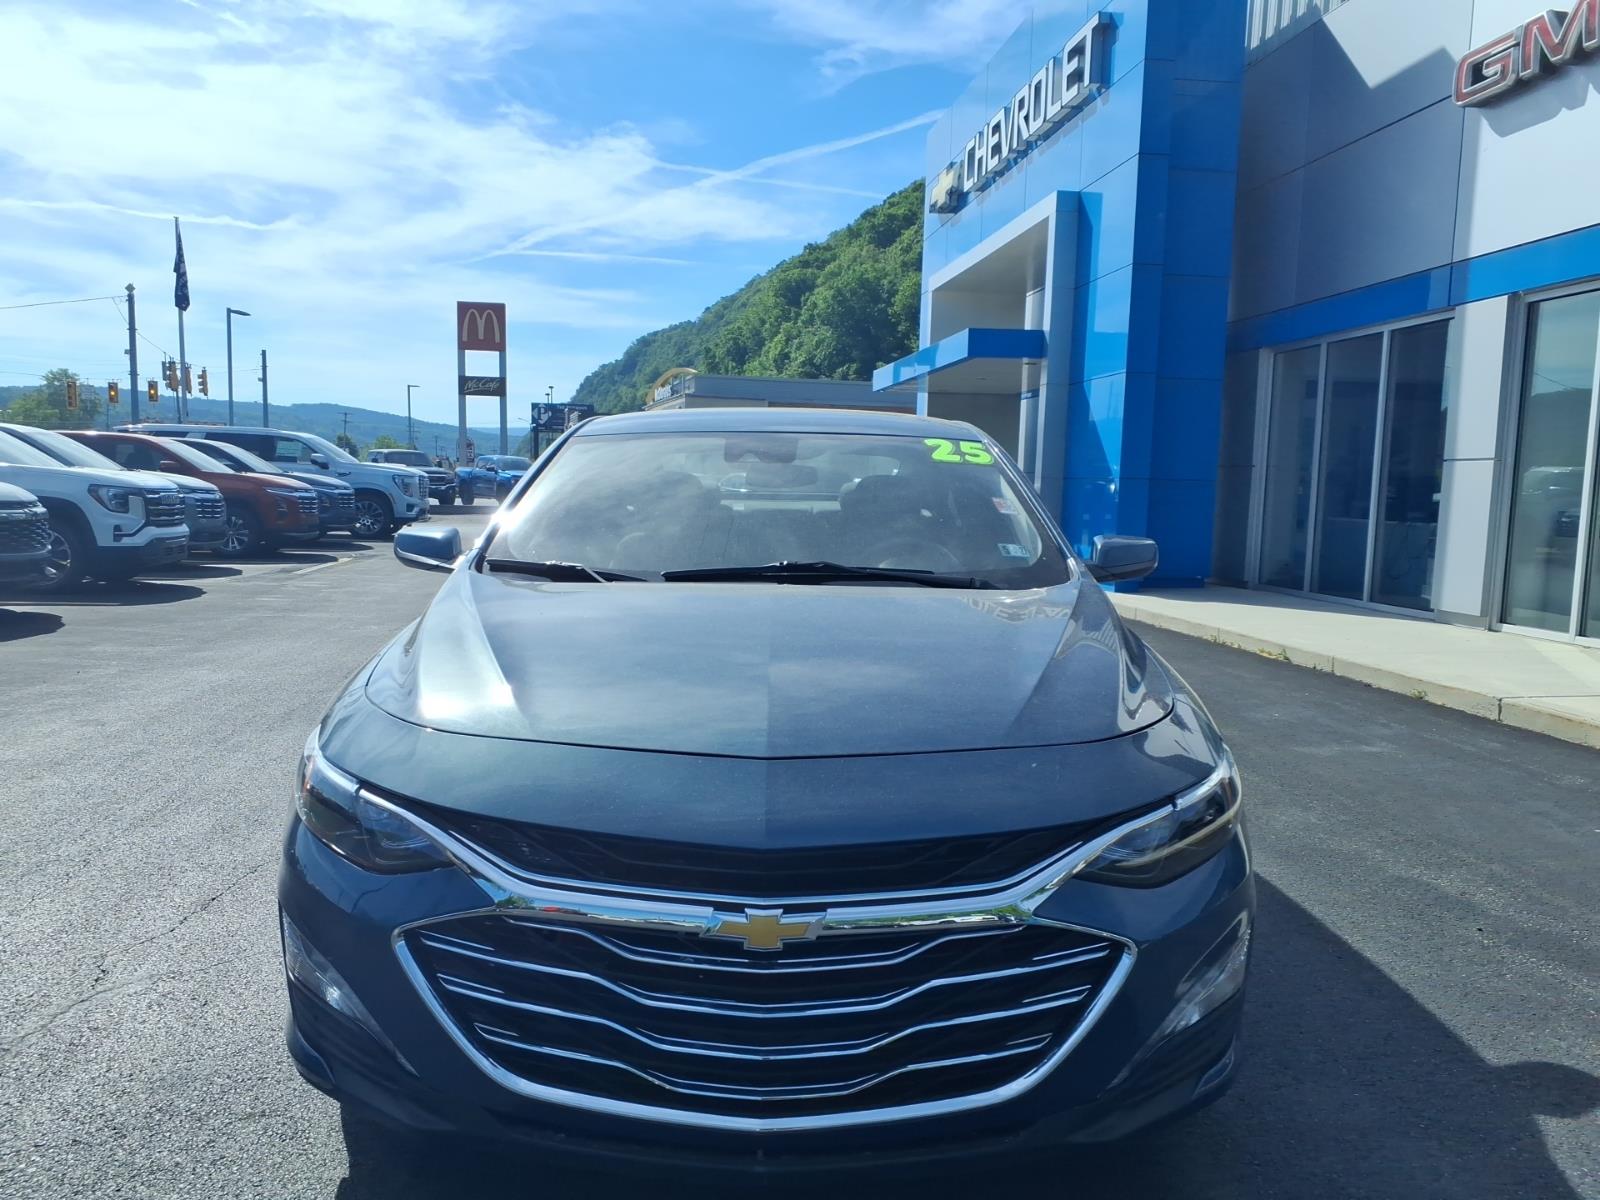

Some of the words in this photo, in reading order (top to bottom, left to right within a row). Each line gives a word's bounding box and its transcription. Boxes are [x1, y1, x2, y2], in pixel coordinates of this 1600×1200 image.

[963, 12, 1100, 192] CHEVROLET
[1452, 0, 1600, 107] GM
[924, 439, 994, 465] 25
